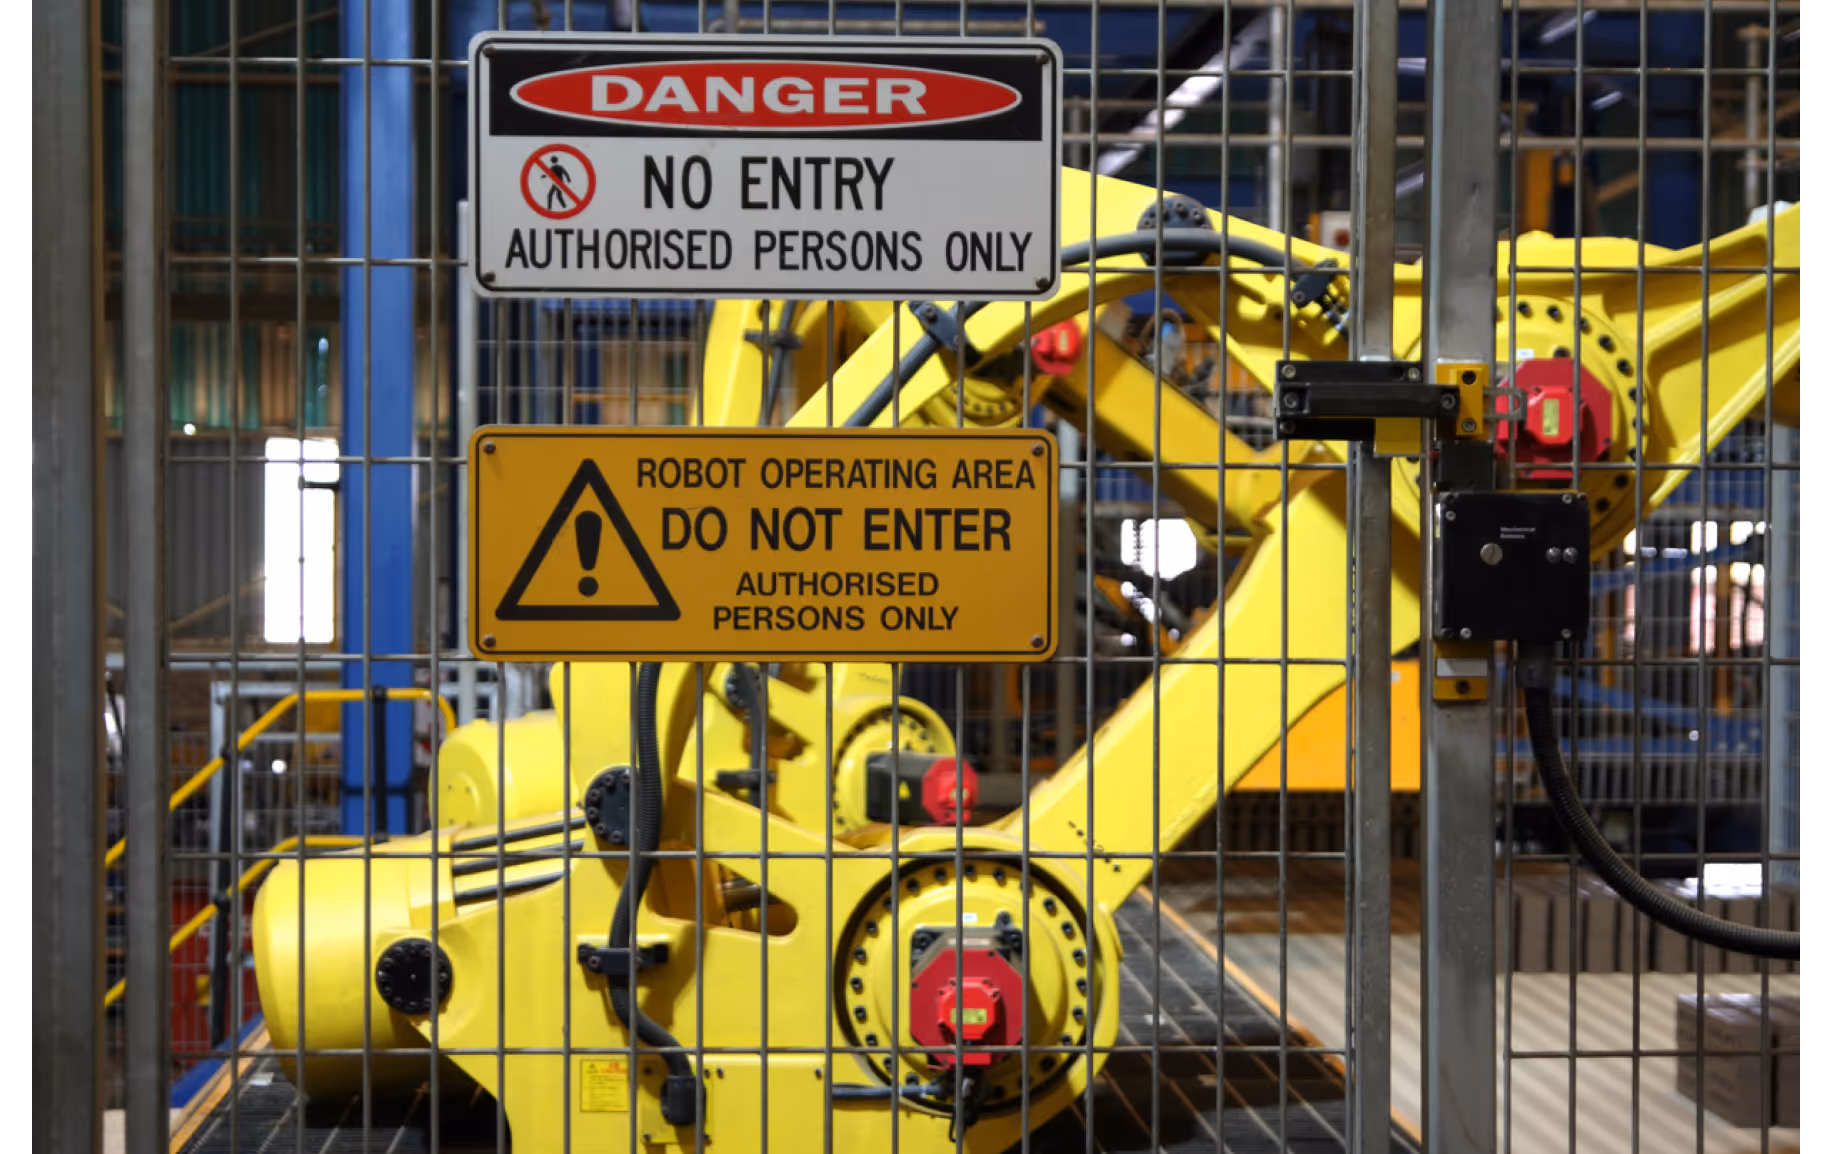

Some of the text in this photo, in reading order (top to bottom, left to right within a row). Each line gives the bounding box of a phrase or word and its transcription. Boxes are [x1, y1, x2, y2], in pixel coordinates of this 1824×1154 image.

[591, 74, 927, 115] DANGER
[644, 155, 895, 210] NO ENTRY
[505, 228, 1032, 271] AUTHORISED PERSONS ONLY
[637, 458, 1035, 489] ROBOT OPERATING AREA
[662, 507, 1010, 551] DO NOT ENTER
[736, 572, 939, 596] AUTHORISED
[713, 606, 959, 631] PERSONS ONLY
